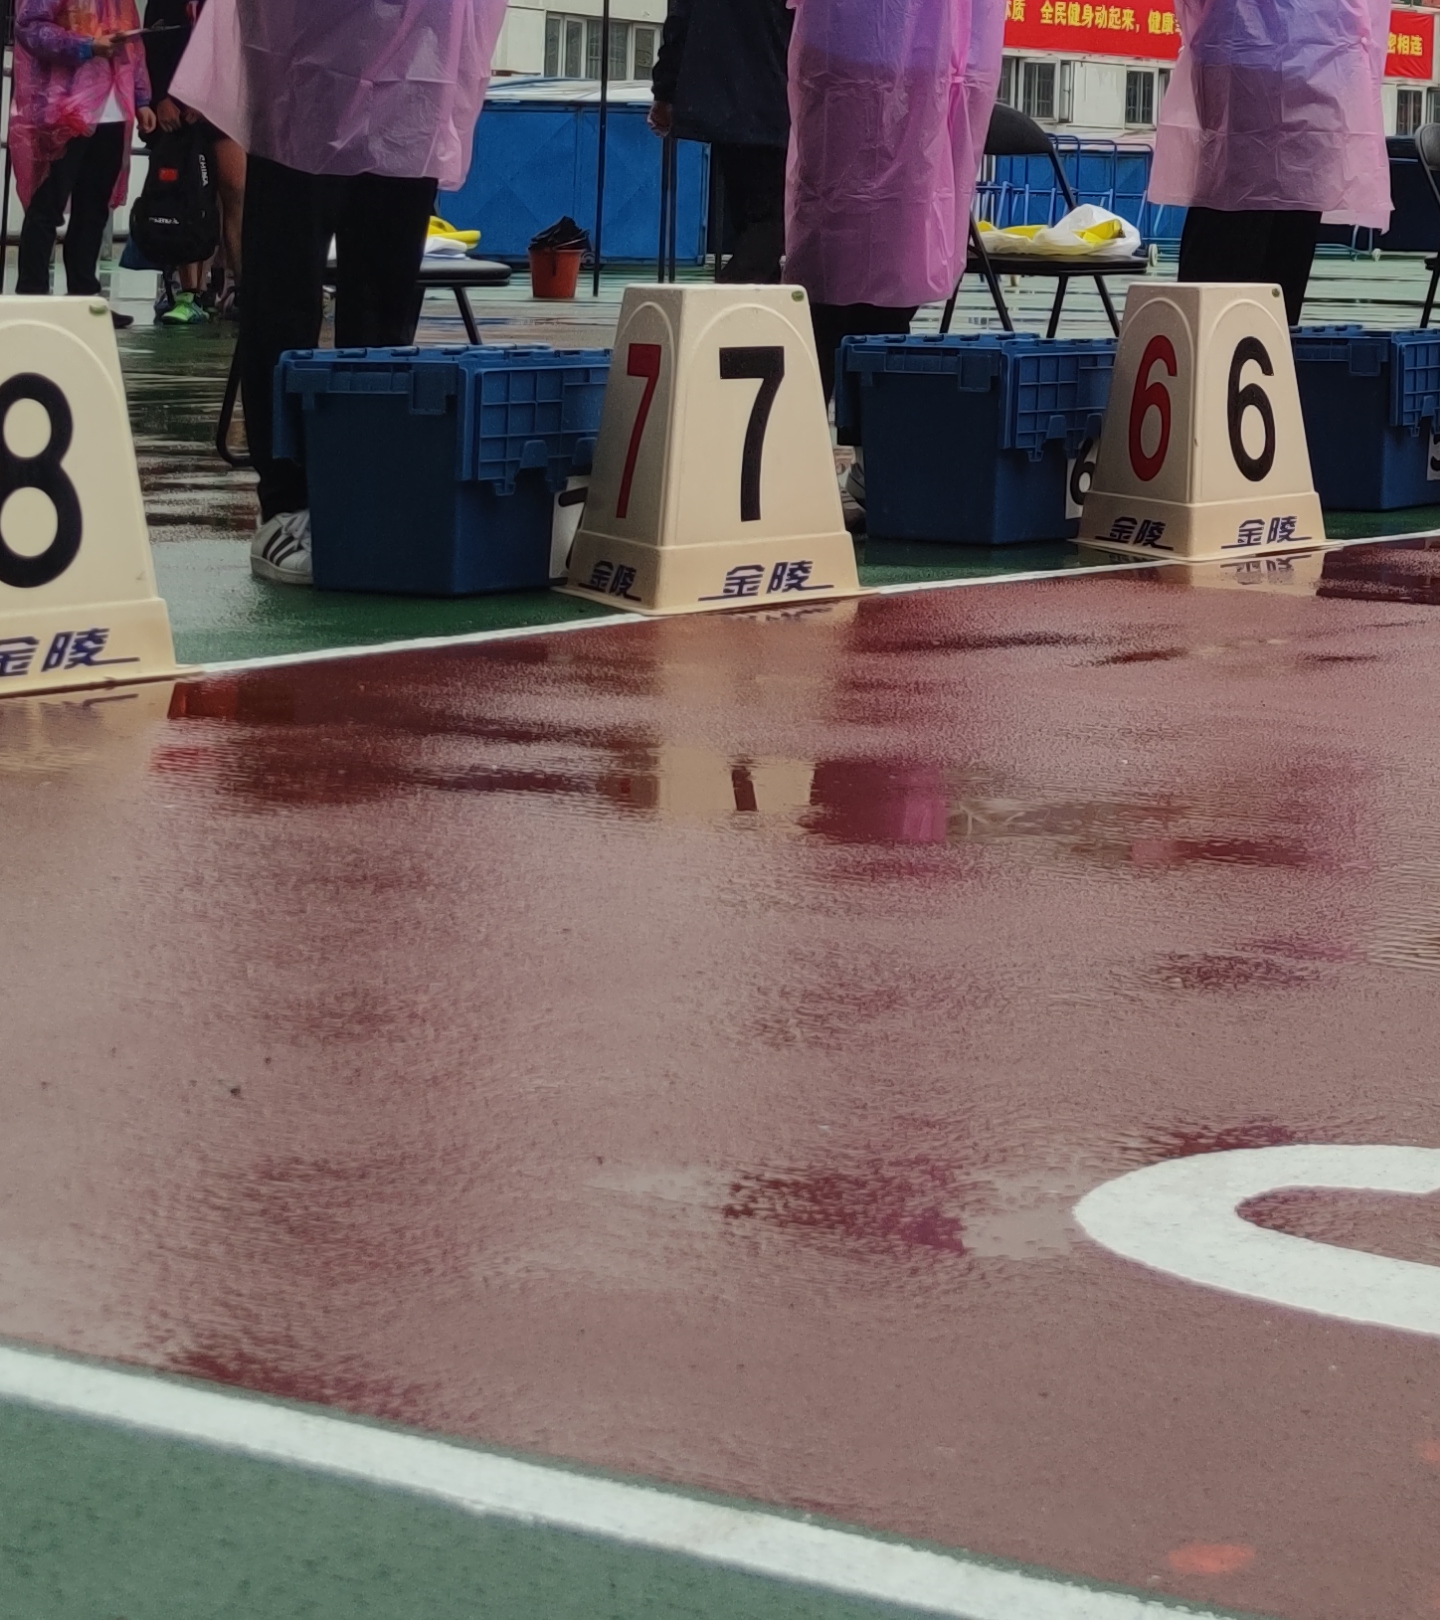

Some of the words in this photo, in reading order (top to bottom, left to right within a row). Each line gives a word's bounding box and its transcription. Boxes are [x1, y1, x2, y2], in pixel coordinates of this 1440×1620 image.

[1040, 0, 1183, 36] 全民健身动起来，健康
[199, 154, 209, 187] CHINA
[616, 343, 662, 520] 7
[719, 346, 785, 522] 7
[1128, 334, 1179, 482] 6
[1227, 336, 1277, 483] 6
[1221, 515, 1313, 550] 金陵
[698, 559, 834, 602] 金陵
